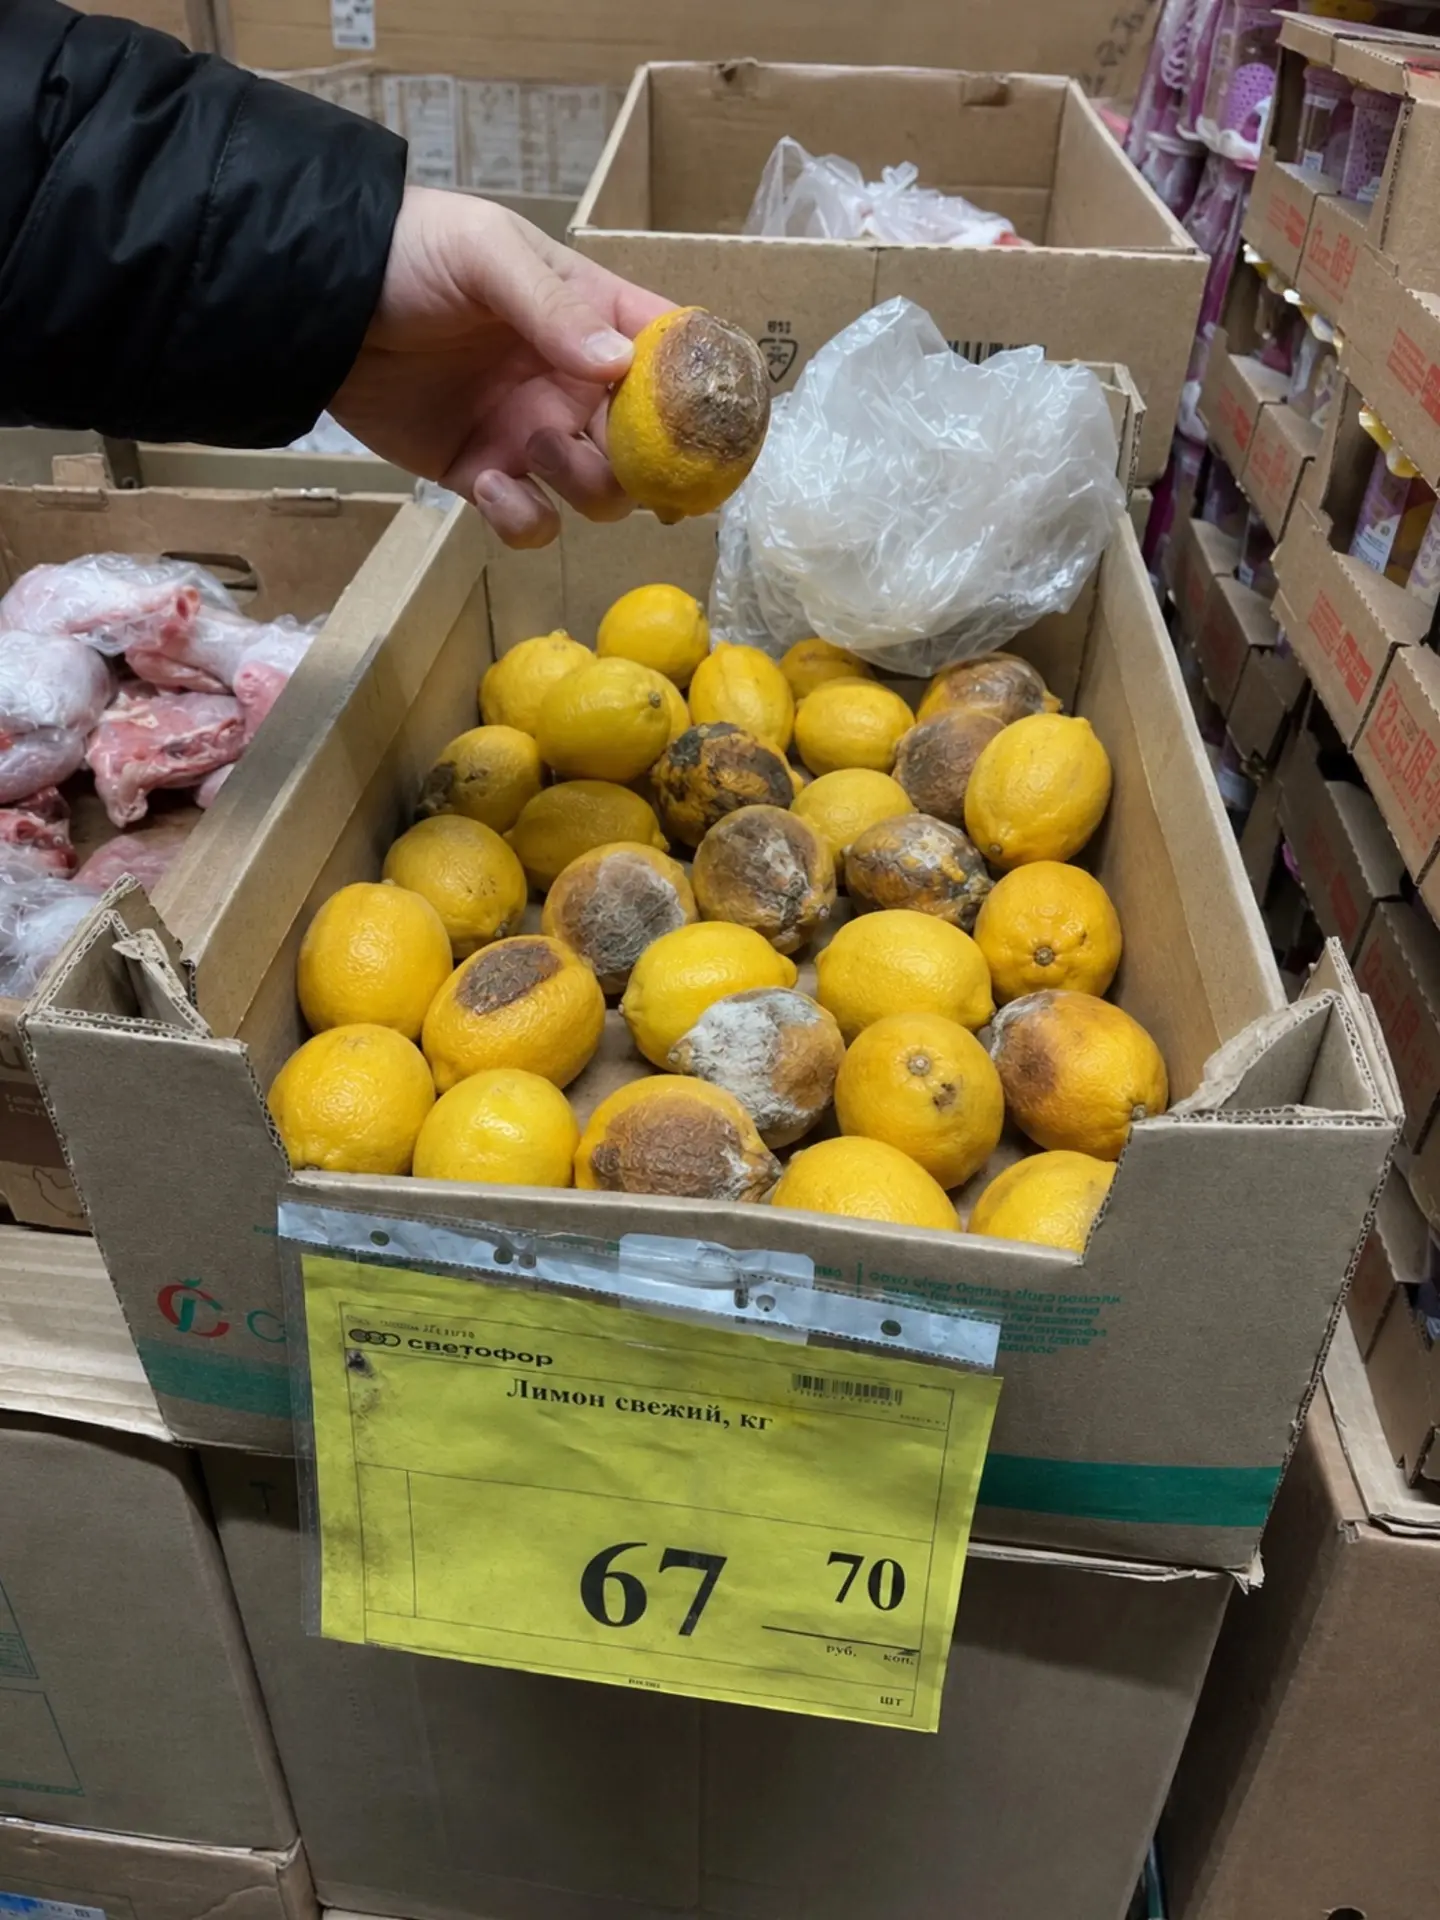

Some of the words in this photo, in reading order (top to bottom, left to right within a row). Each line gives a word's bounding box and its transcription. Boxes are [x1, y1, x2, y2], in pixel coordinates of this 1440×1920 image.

[408, 1337, 553, 1366] светофор
[507, 1378, 605, 1408] Лимон
[615, 1396, 730, 1430] свежий,
[740, 1413, 773, 1431] кг
[580, 1541, 728, 1637] 67
[826, 1551, 906, 1612] 70
[879, 1695, 903, 1707] шт
